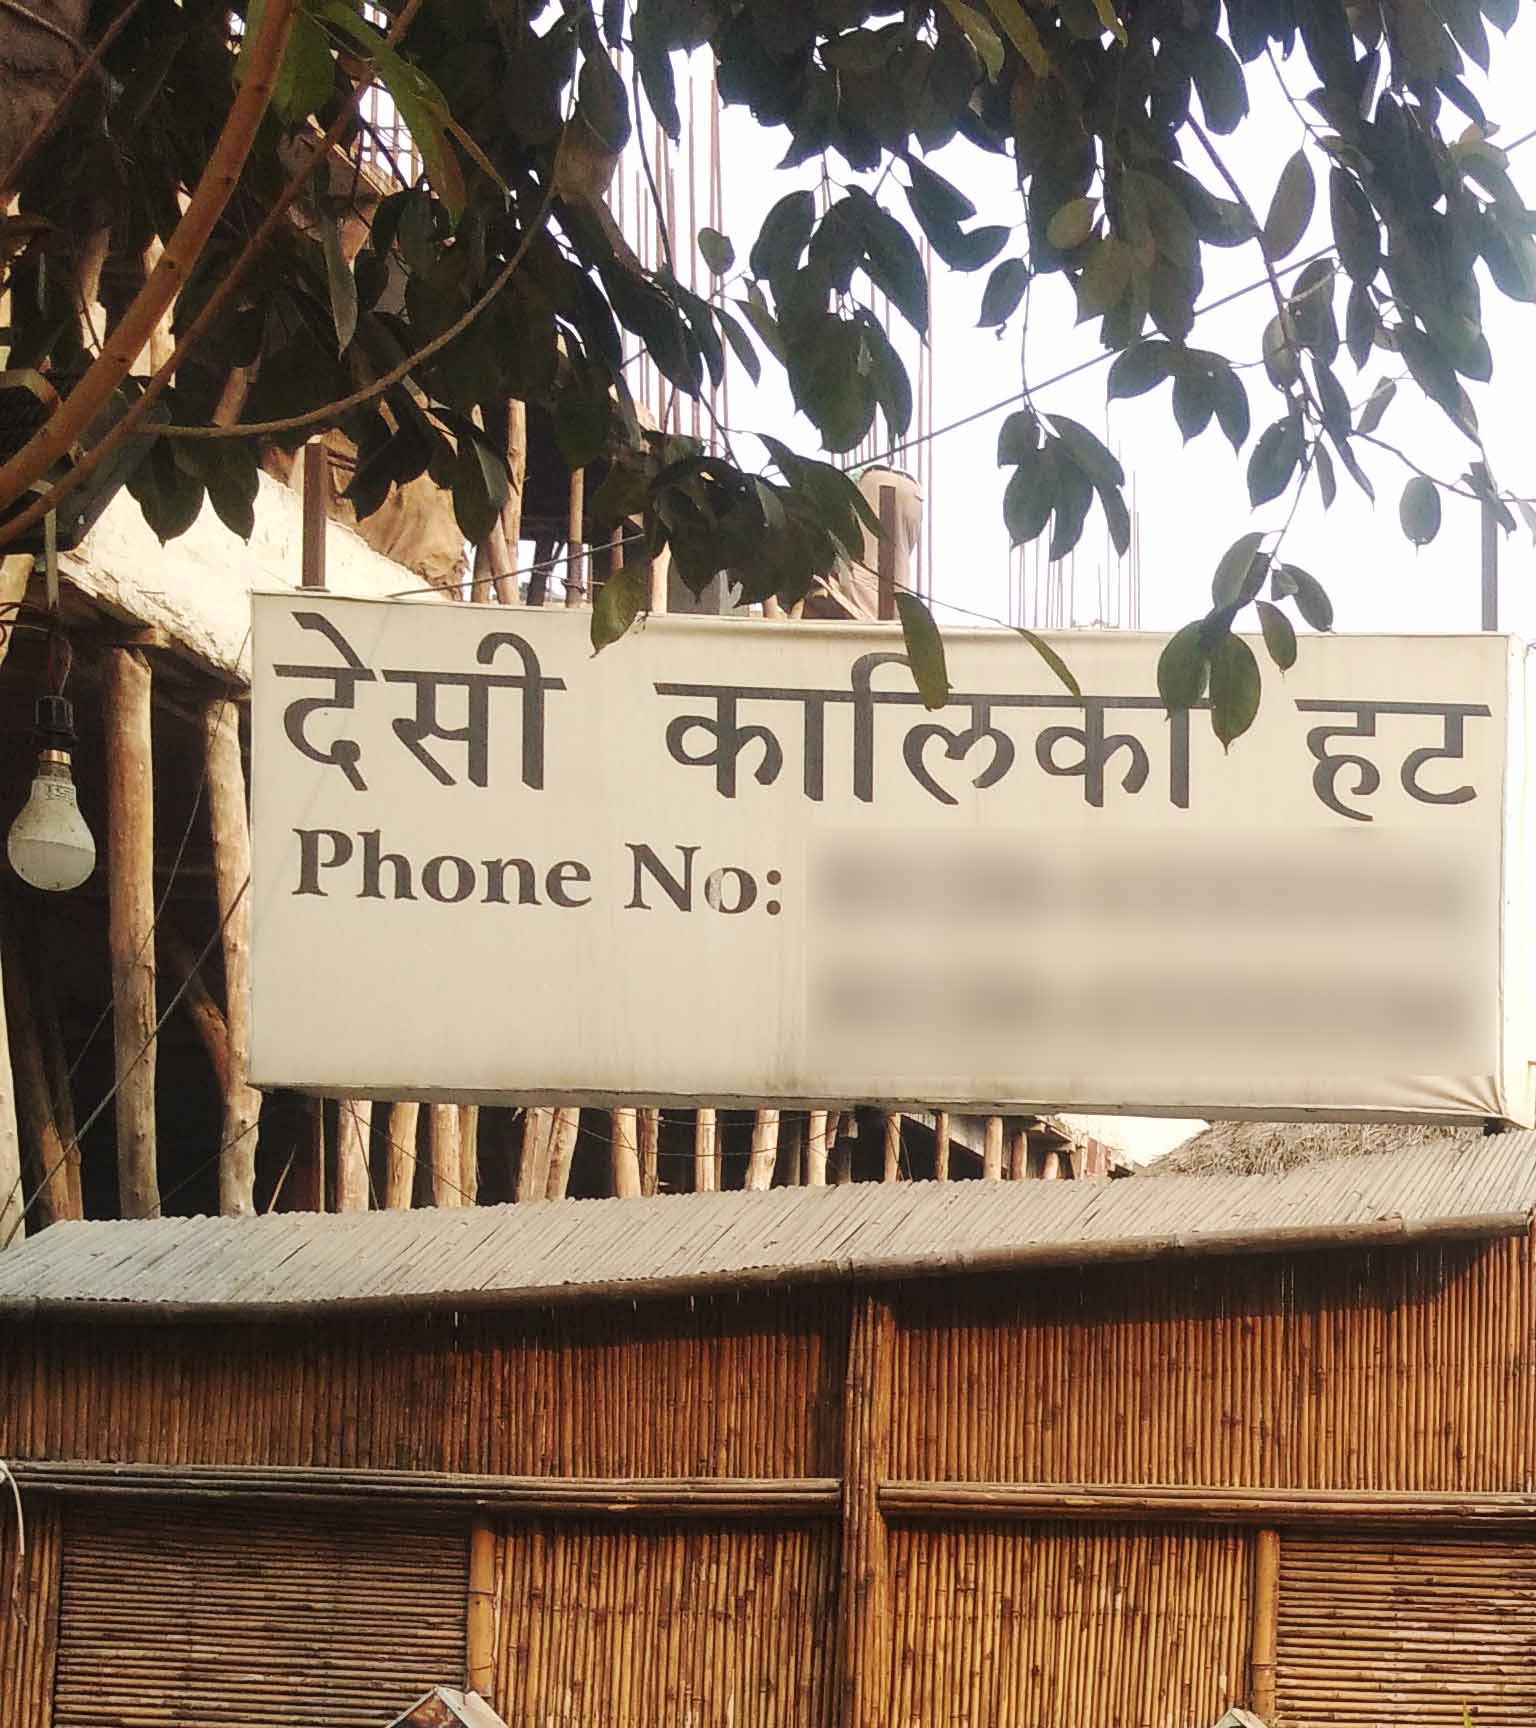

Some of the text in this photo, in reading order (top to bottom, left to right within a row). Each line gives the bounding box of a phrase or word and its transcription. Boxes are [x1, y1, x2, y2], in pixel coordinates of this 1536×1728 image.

[273, 611, 1492, 821] देसी कालिका हट
[291, 828, 593, 908] Phone
[624, 842, 782, 915] No:
